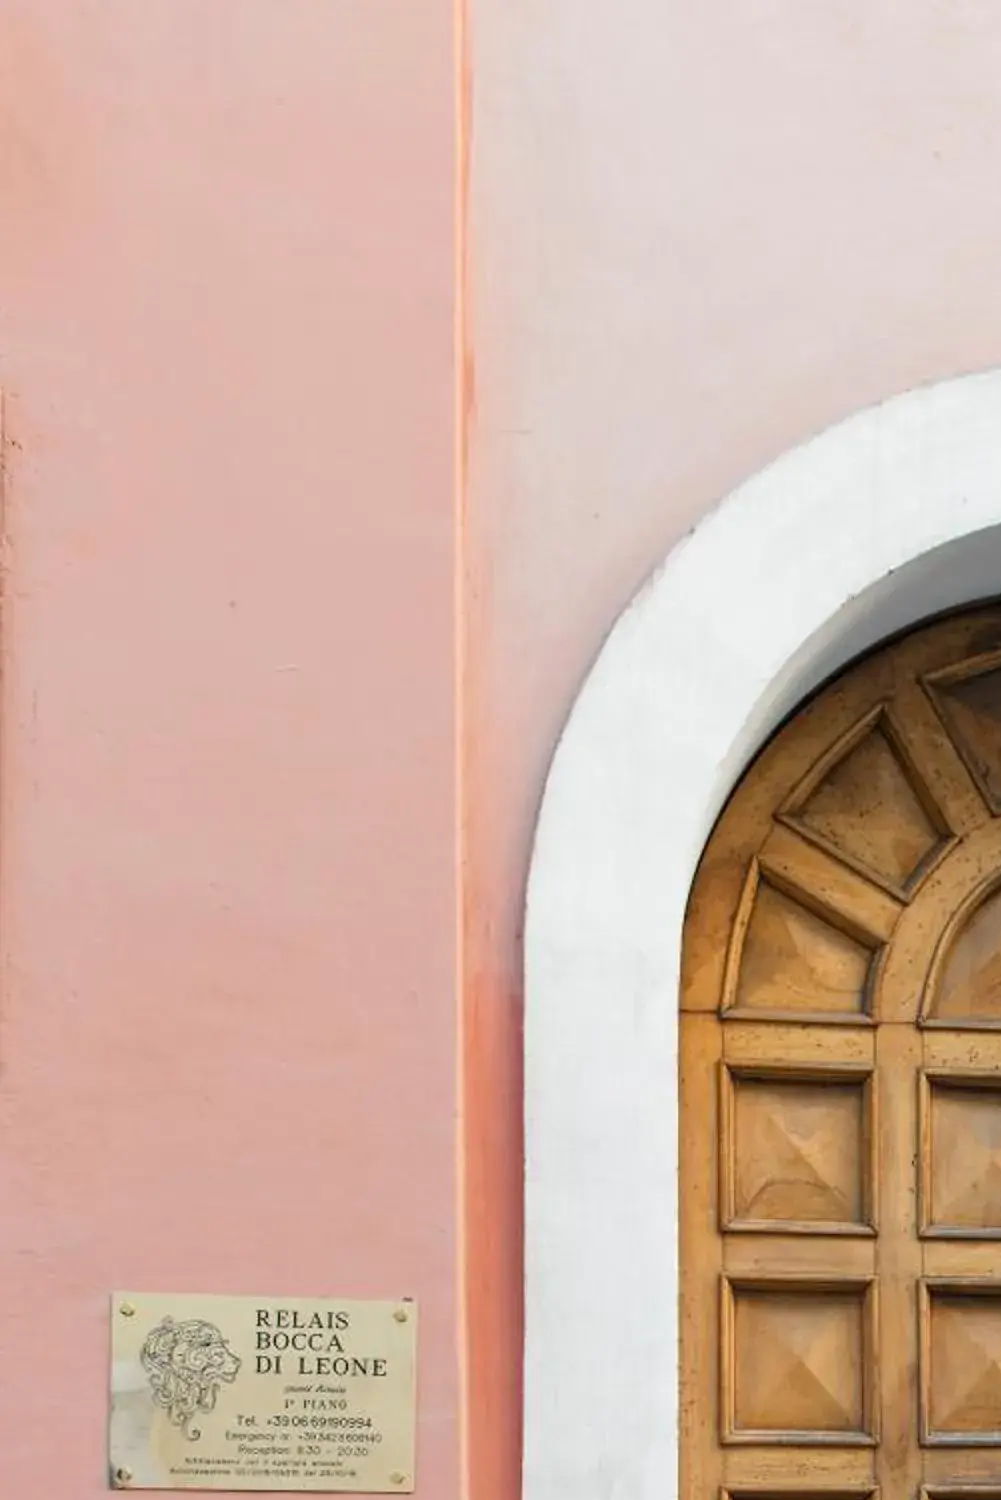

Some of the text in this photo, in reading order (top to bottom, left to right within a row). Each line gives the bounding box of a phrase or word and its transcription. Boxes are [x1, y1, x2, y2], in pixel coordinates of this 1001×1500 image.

[256, 1309, 350, 1330] RELAIS
[256, 1331, 345, 1353] BOCCA
[256, 1356, 387, 1377] DI LEONE
